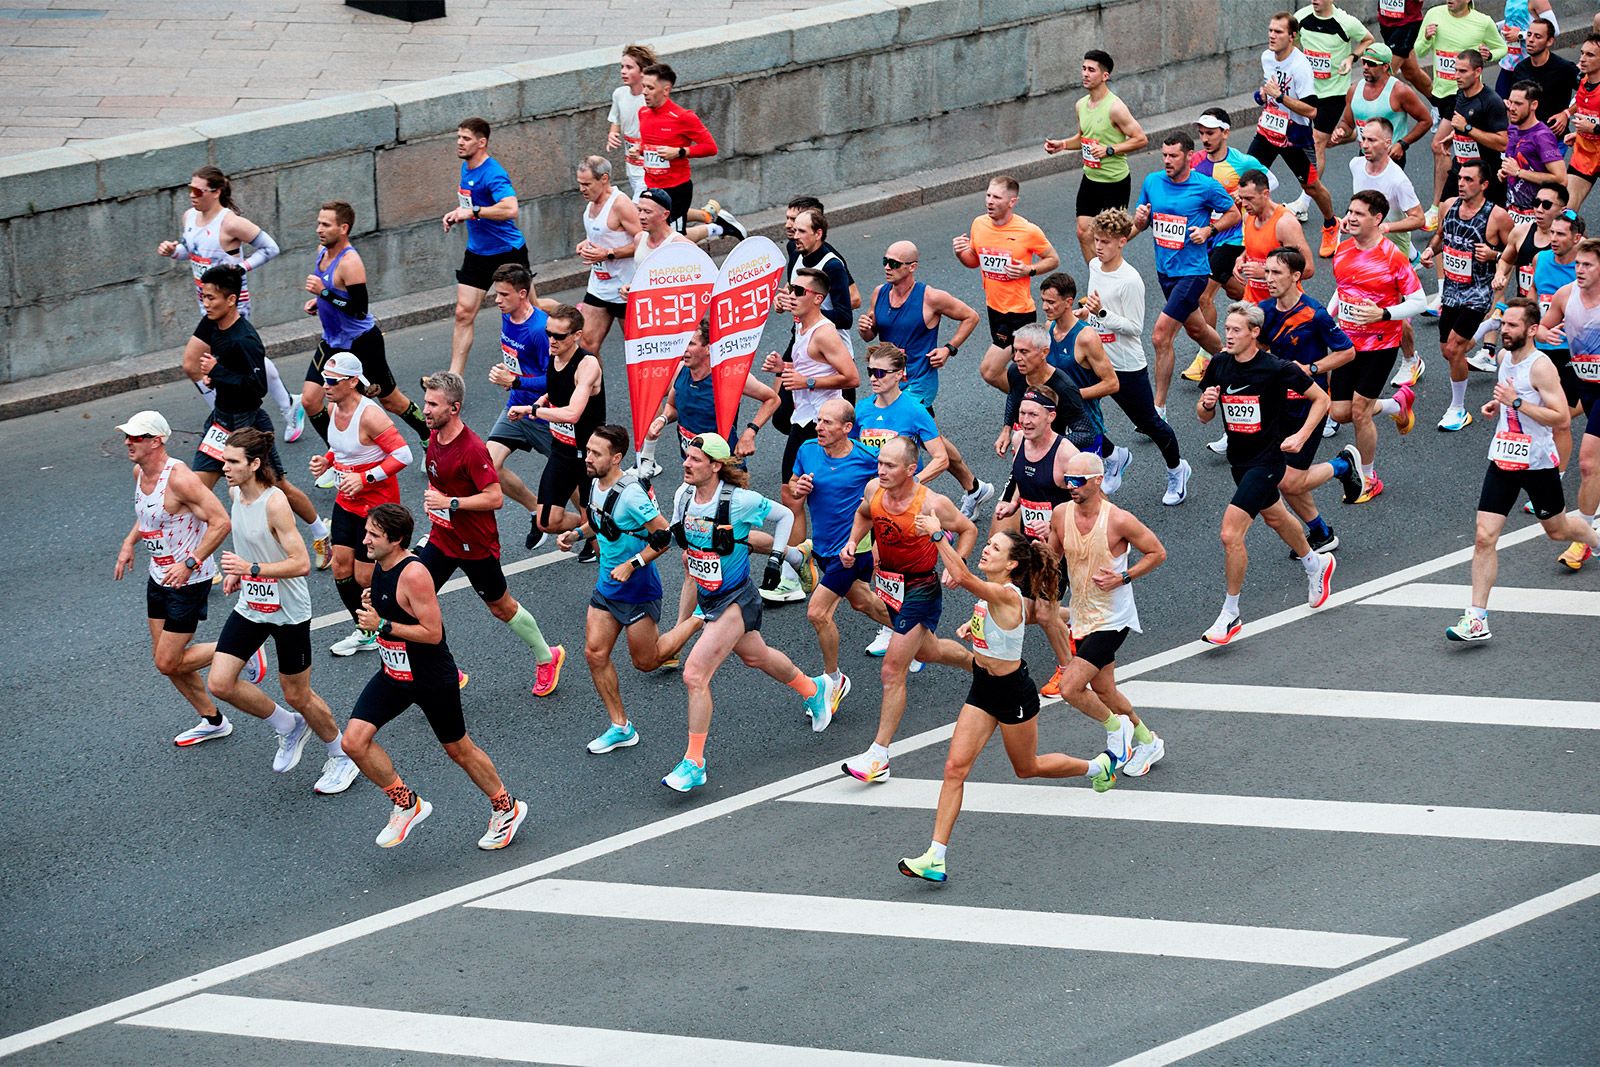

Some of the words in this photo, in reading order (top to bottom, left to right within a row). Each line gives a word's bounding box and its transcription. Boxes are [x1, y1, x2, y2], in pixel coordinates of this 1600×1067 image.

[1265, 114, 1285, 128] 9718
[1155, 220, 1185, 236] 11400
[728, 254, 770, 277] МАРАФОН
[983, 256, 1008, 268] 2977
[1445, 256, 1467, 270] 5559
[649, 264, 702, 278] МАРАФОН
[728, 267, 766, 287] МОСКВА
[649, 273, 688, 286] МОСКВА
[635, 292, 698, 330] 0:39
[717, 282, 771, 330] 0:39
[637, 342, 660, 357] 3:54
[719, 340, 740, 357] 3:54
[1574, 361, 1600, 375] 1647
[1227, 405, 1254, 417] 8299
[1496, 440, 1528, 457] 11025
[688, 556, 719, 574] 25589
[247, 583, 274, 597] 2904
